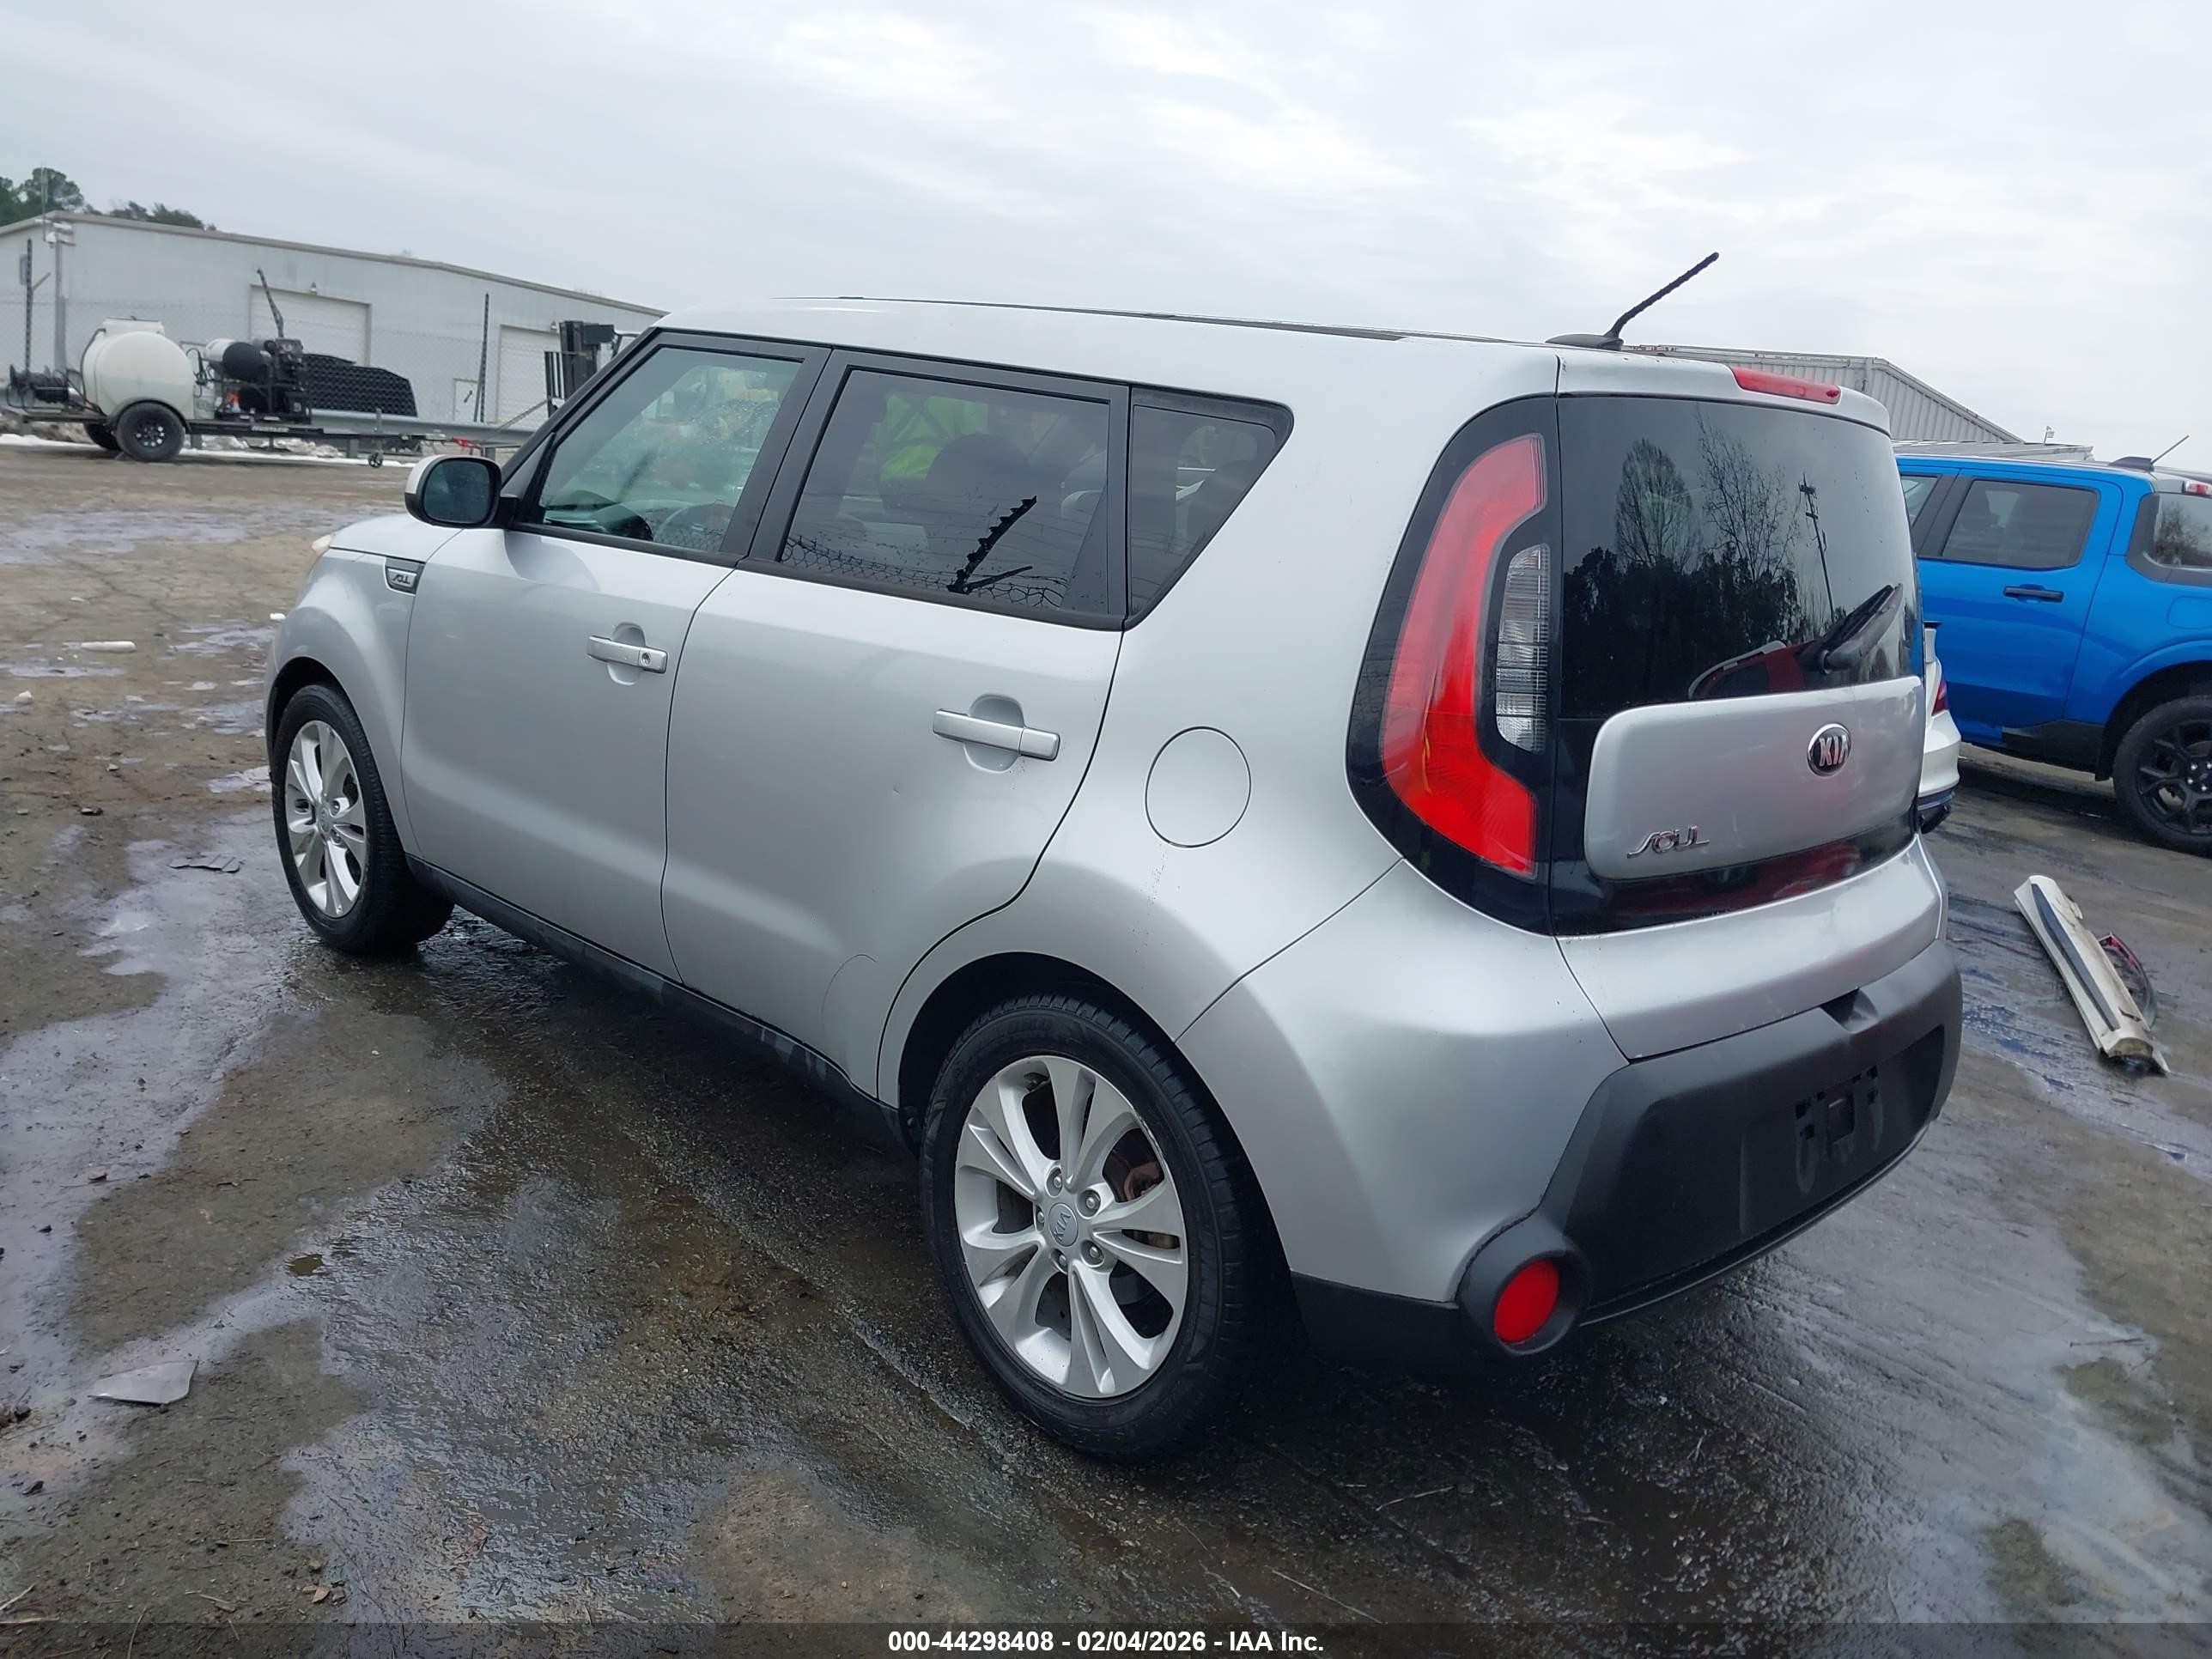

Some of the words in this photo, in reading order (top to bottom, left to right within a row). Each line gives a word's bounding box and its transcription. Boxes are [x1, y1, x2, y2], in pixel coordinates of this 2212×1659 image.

[1819, 734, 1849, 767] KIA
[1626, 825, 1711, 860] SOUL
[1050, 1212, 1072, 1243] KIA
